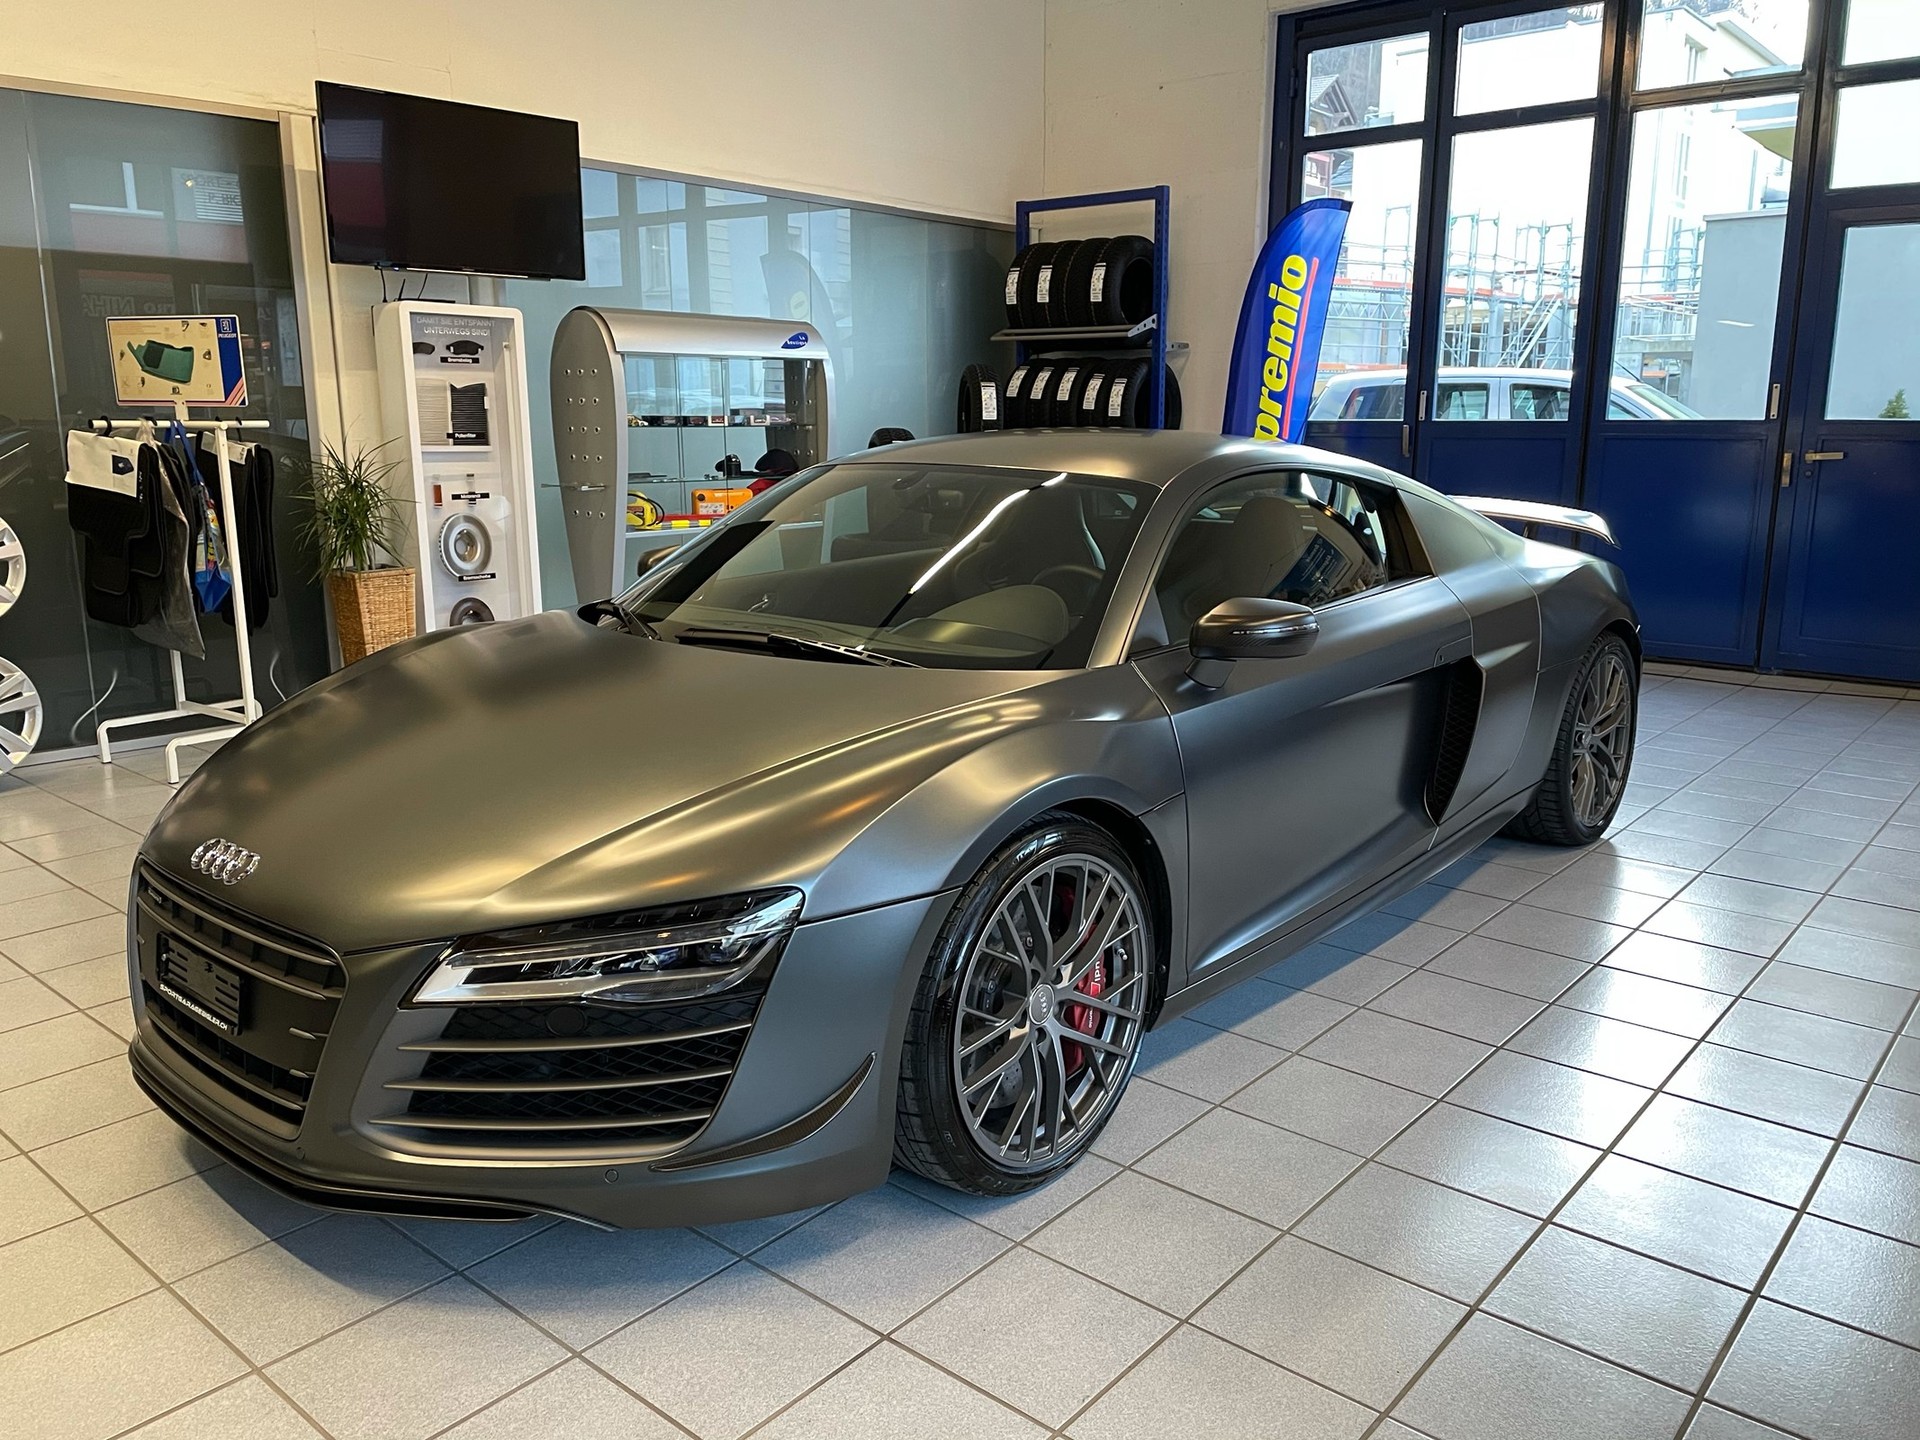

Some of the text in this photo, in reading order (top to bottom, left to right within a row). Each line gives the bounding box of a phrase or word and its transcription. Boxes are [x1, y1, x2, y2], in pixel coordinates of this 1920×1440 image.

[416, 316, 496, 327] DAMIT SIE ENTSPANNT
[423, 326, 490, 337] UNTERWEGS SIND!
[1254, 254, 1307, 440] premio
